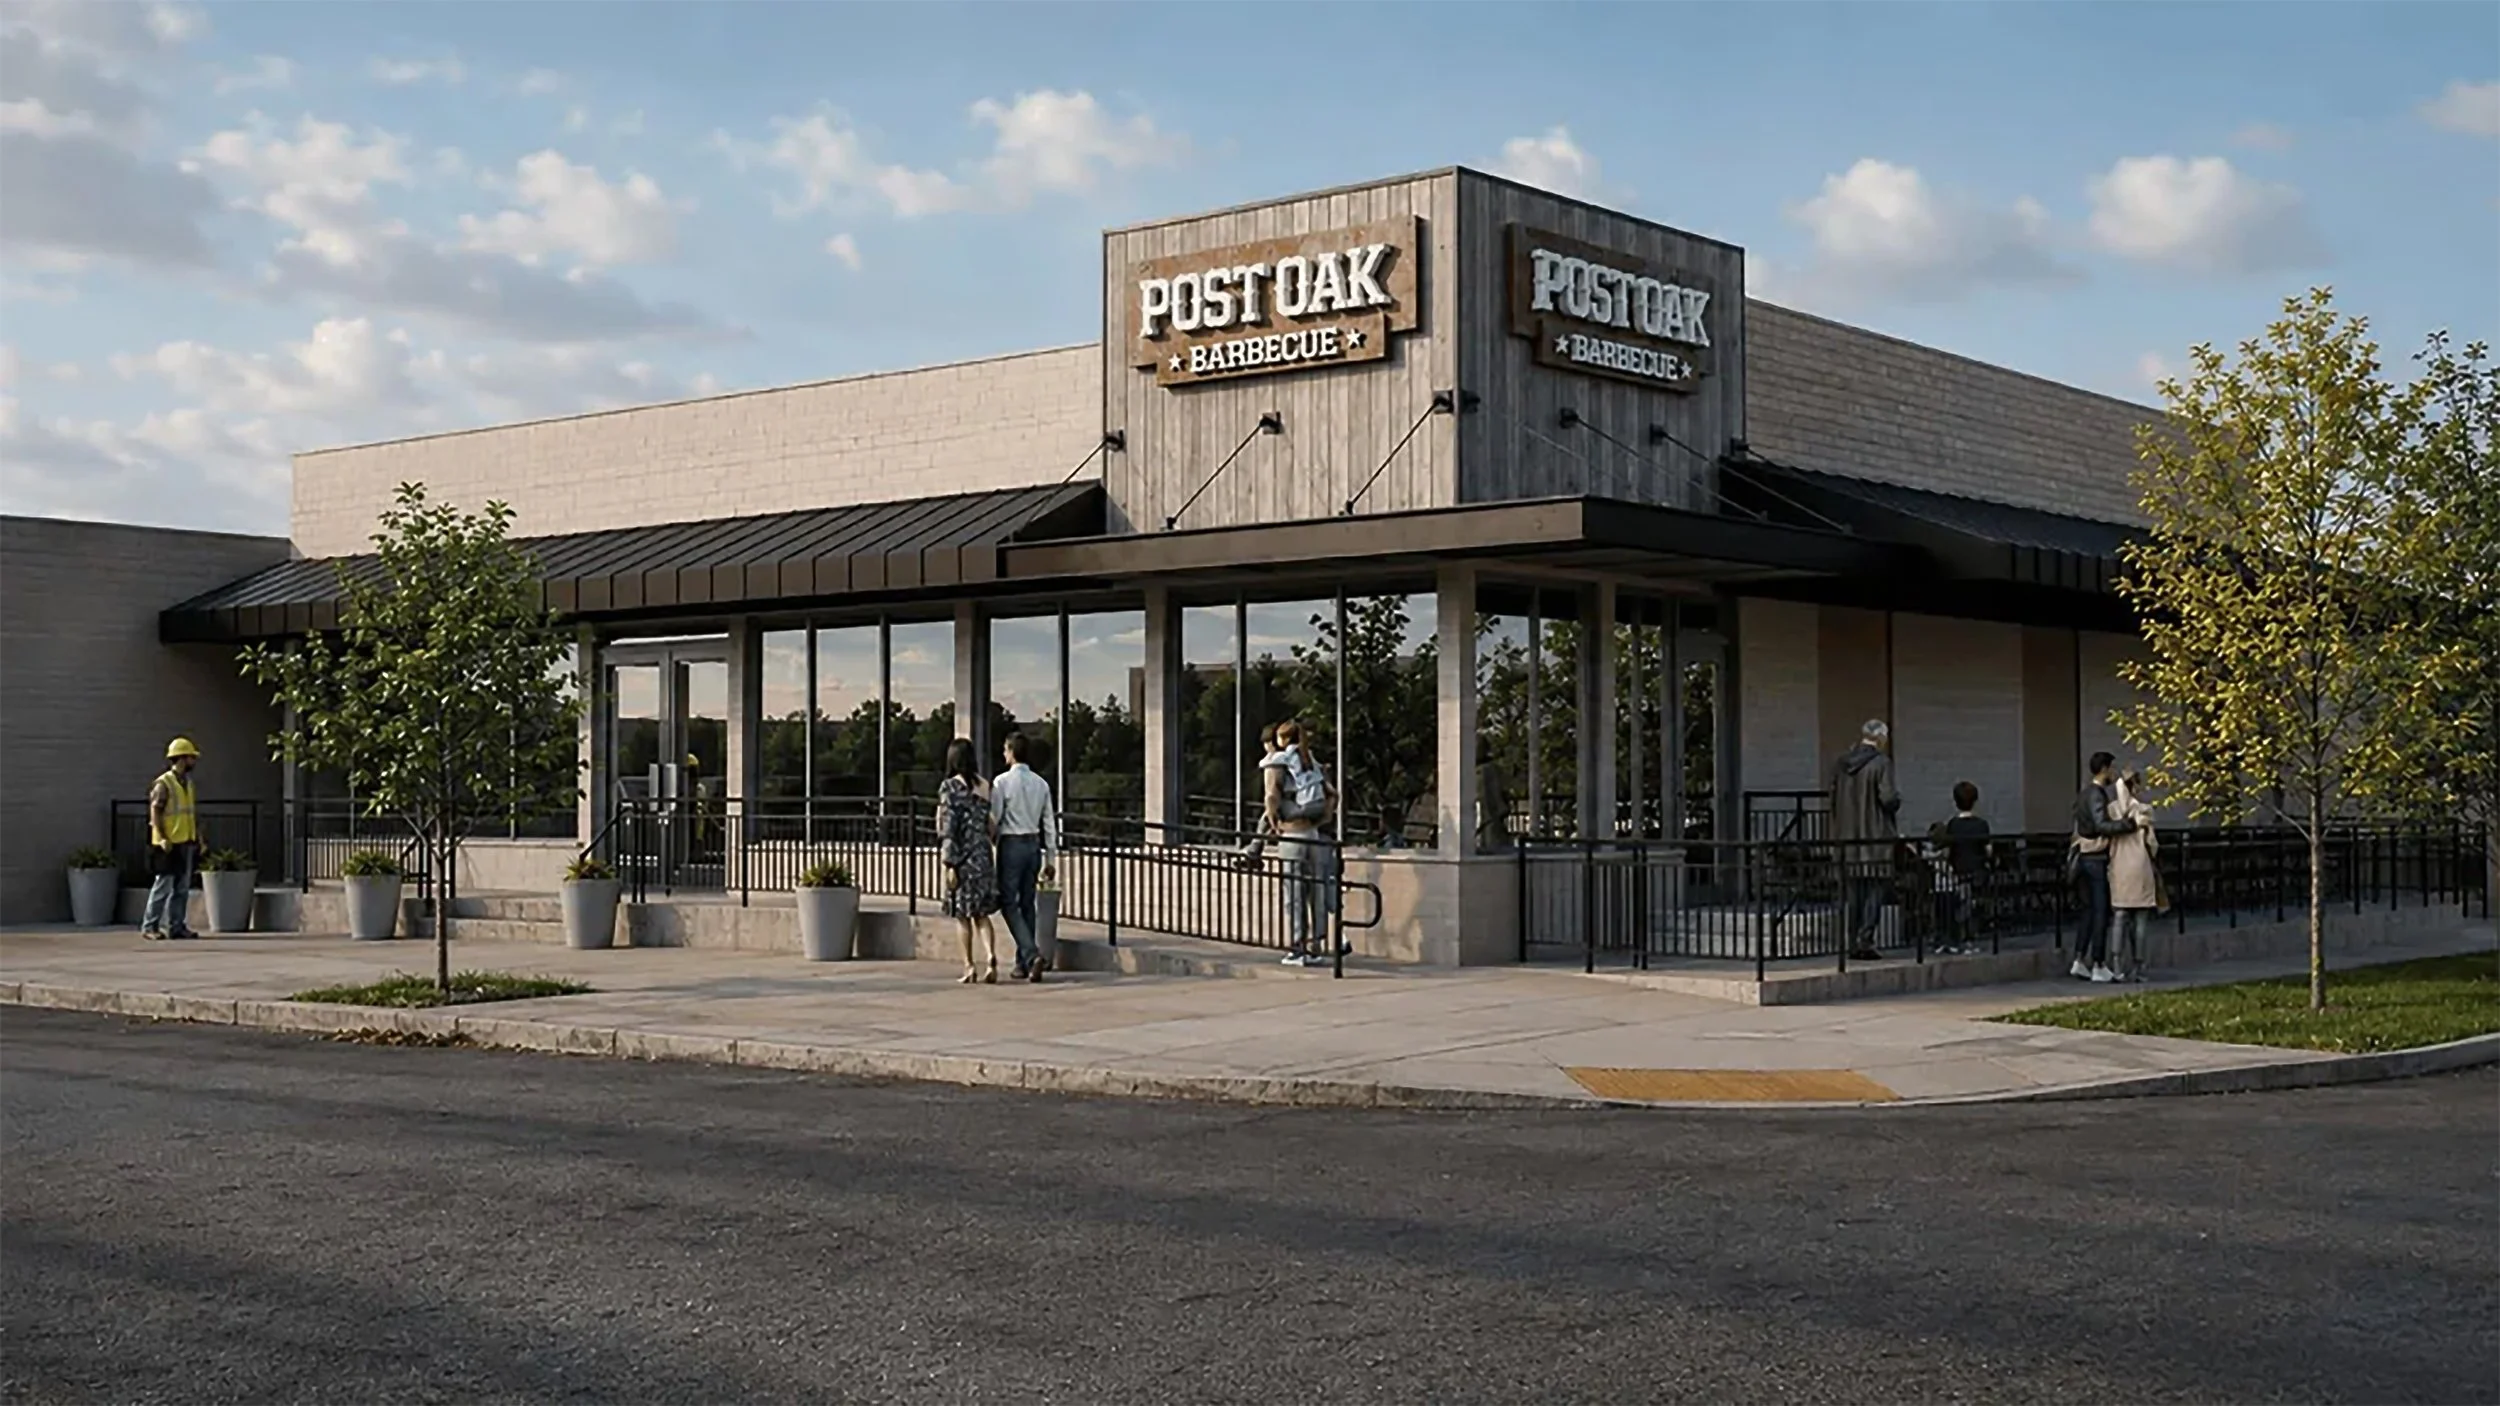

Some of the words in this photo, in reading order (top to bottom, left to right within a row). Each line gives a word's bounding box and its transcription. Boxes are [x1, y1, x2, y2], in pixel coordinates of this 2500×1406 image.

[1139, 262, 1270, 338] POST
[1274, 243, 1392, 317] OAK
[1531, 249, 1634, 328] POST
[1632, 276, 1710, 347] OAK
[1189, 327, 1338, 373] BARBECUE
[1570, 334, 1678, 380] BARBECUE
